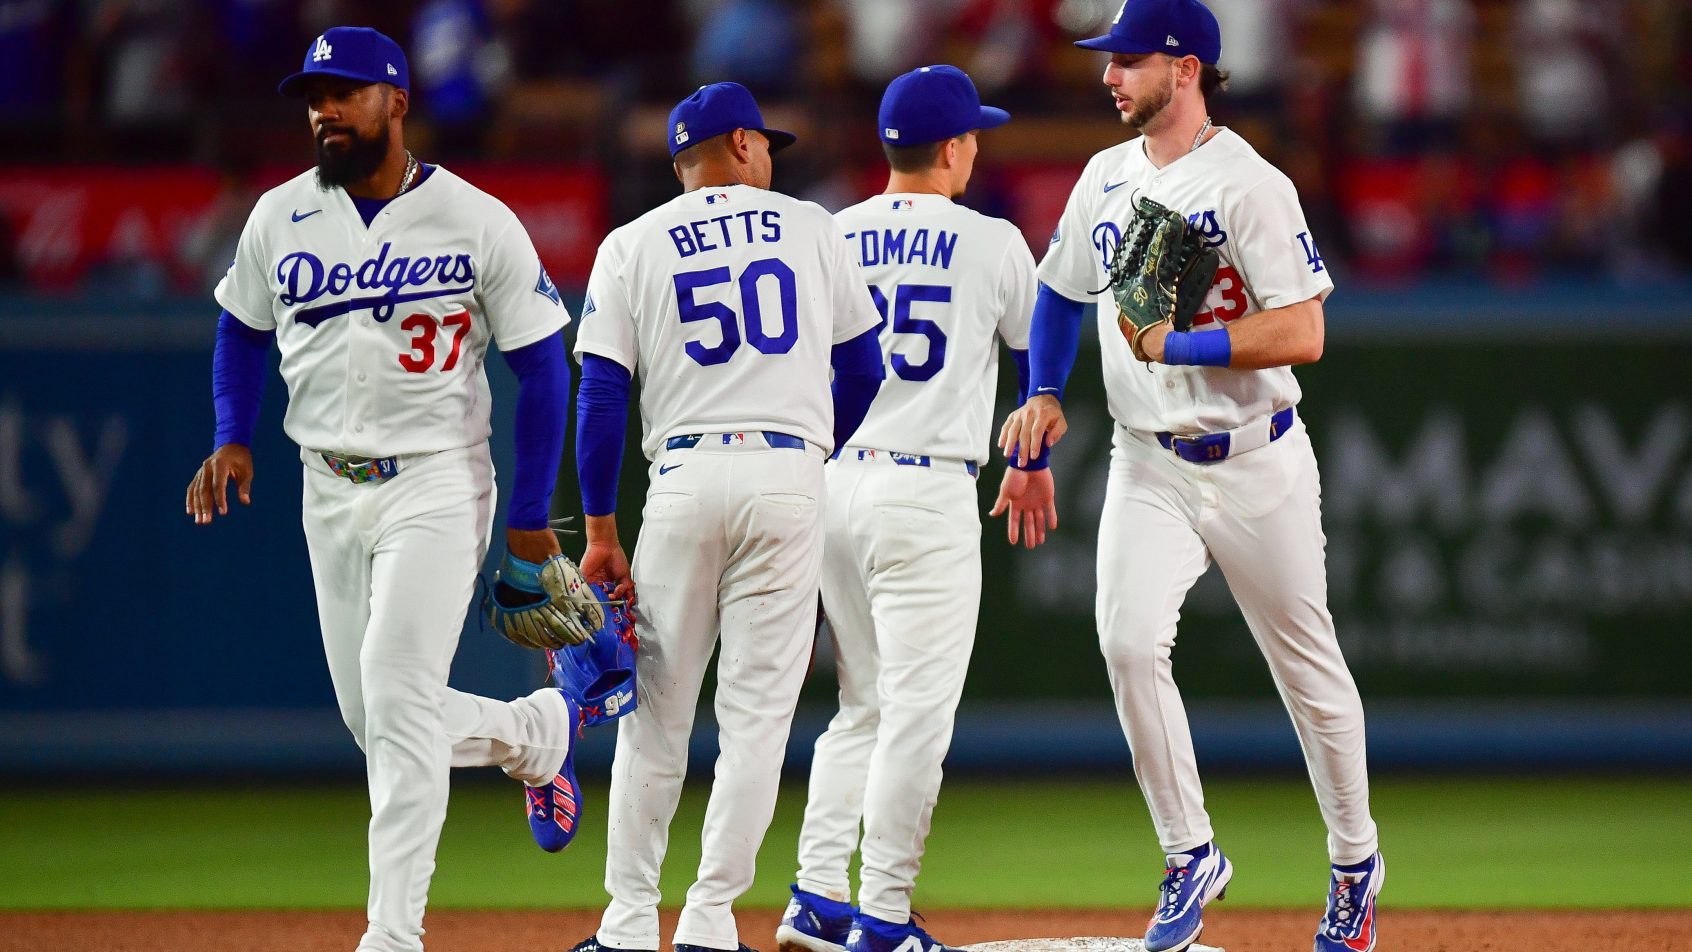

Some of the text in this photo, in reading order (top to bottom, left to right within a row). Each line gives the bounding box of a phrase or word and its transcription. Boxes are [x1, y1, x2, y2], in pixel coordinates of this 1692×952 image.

[313, 34, 332, 62] LA
[668, 210, 781, 258] BETTS
[845, 229, 958, 270] DMAN
[1296, 231, 1325, 273] LA
[277, 242, 475, 324] Dodgers
[673, 258, 799, 367] 50
[398, 310, 472, 373] 37
[380, 460, 391, 473] 37
